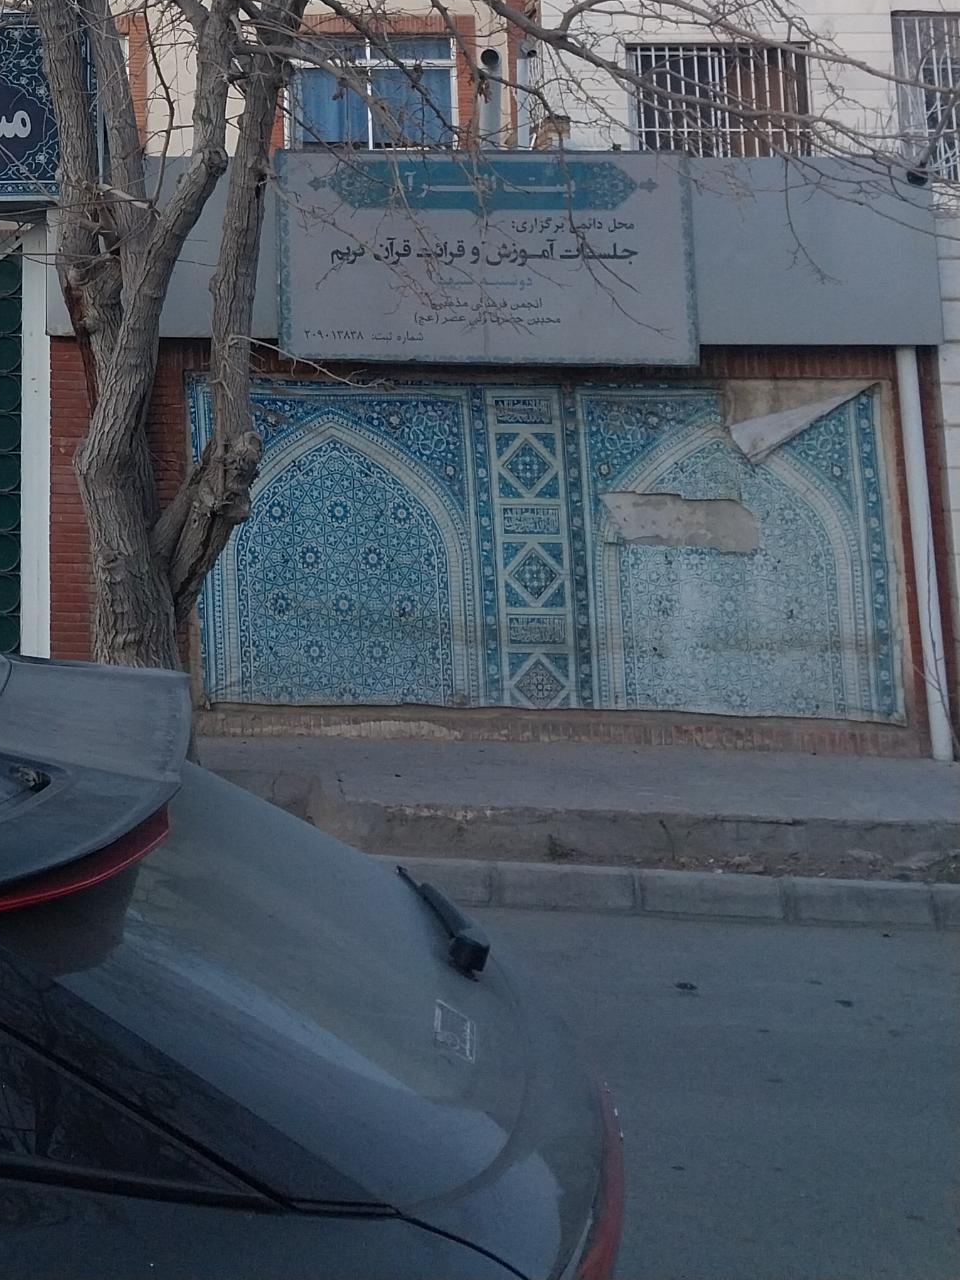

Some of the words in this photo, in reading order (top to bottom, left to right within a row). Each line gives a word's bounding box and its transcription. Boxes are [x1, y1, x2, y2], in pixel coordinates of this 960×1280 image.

[608, 217, 635, 232] محل
[470, 245, 481, 265] و
[486, 238, 558, 266] آموزش
[559, 243, 639, 265] جلسات
[396, 330, 425, 345] شماره
